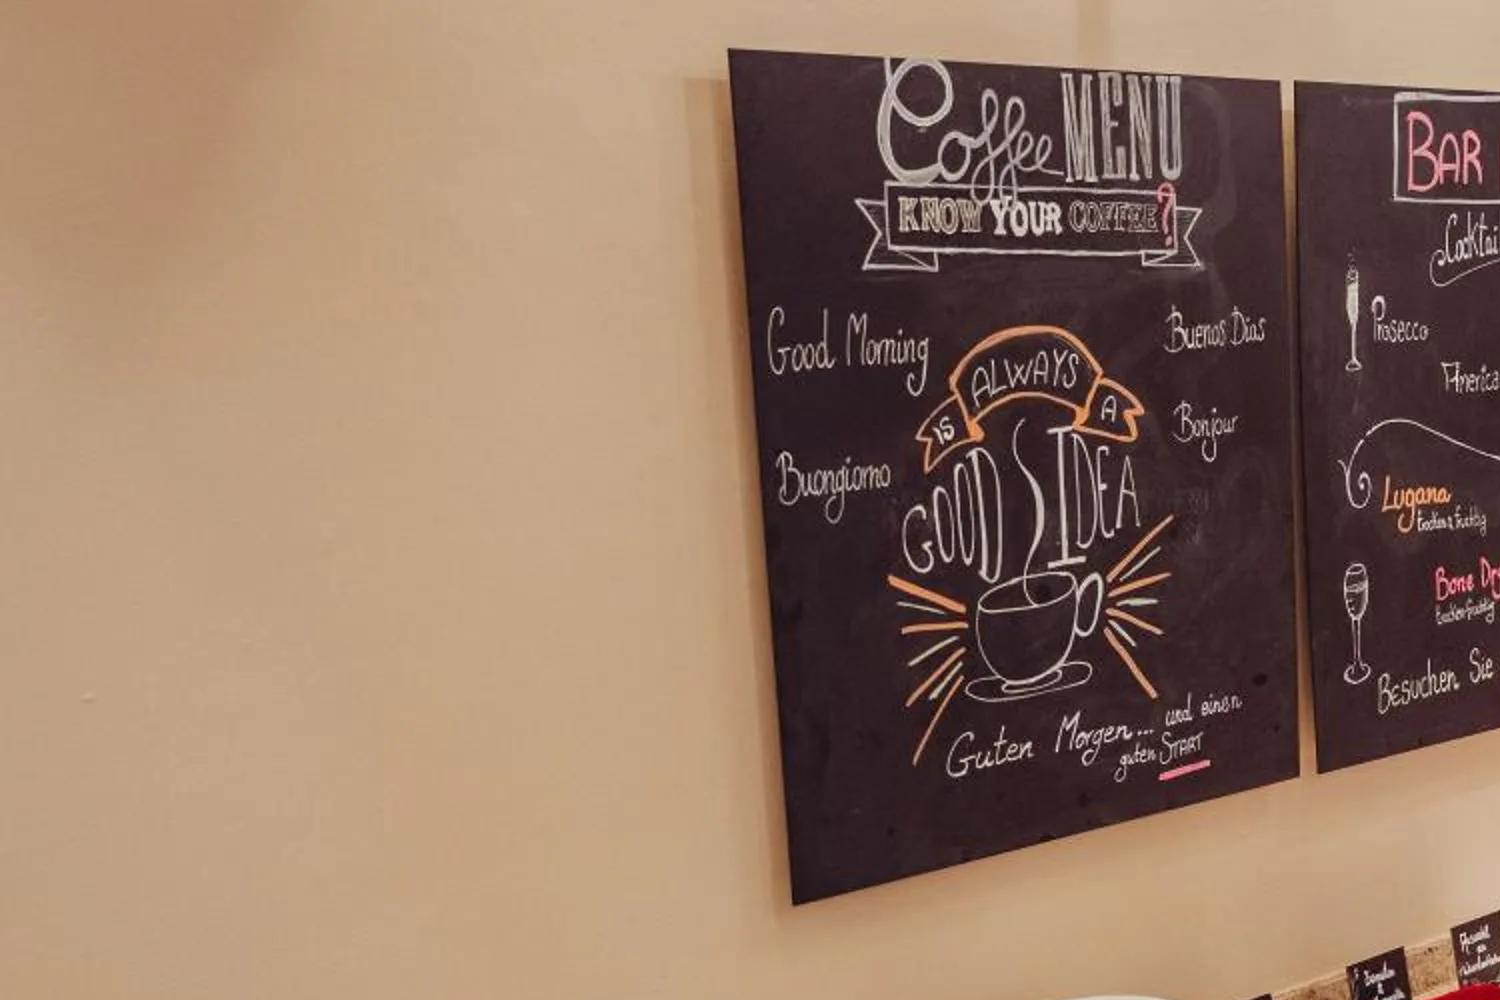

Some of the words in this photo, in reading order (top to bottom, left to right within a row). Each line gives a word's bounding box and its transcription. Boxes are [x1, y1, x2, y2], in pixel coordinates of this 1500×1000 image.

[877, 55, 1063, 203] Coffee
[1061, 72, 1184, 183] MENU
[1407, 111, 1483, 193] BAR
[899, 197, 981, 233] KNOW
[990, 198, 1062, 236] YOUR
[1371, 295, 1429, 342] Prosecco
[767, 306, 836, 376] Good
[846, 312, 929, 397] Morning
[971, 349, 1079, 407] ALWAYS
[1101, 394, 1117, 422] A
[1174, 400, 1239, 463] Bonjour
[776, 451, 891, 524] Buongiorno
[902, 447, 1003, 583] GOOD
[1047, 425, 1141, 568] IDEA
[1381, 474, 1452, 533] Lugana
[1435, 566, 1475, 601] Bone
[1469, 647, 1495, 684] Sie
[1165, 692, 1193, 726] und
[1201, 693, 1243, 718] einen
[946, 725, 1035, 777] Guten
[1113, 742, 1157, 783] guten
